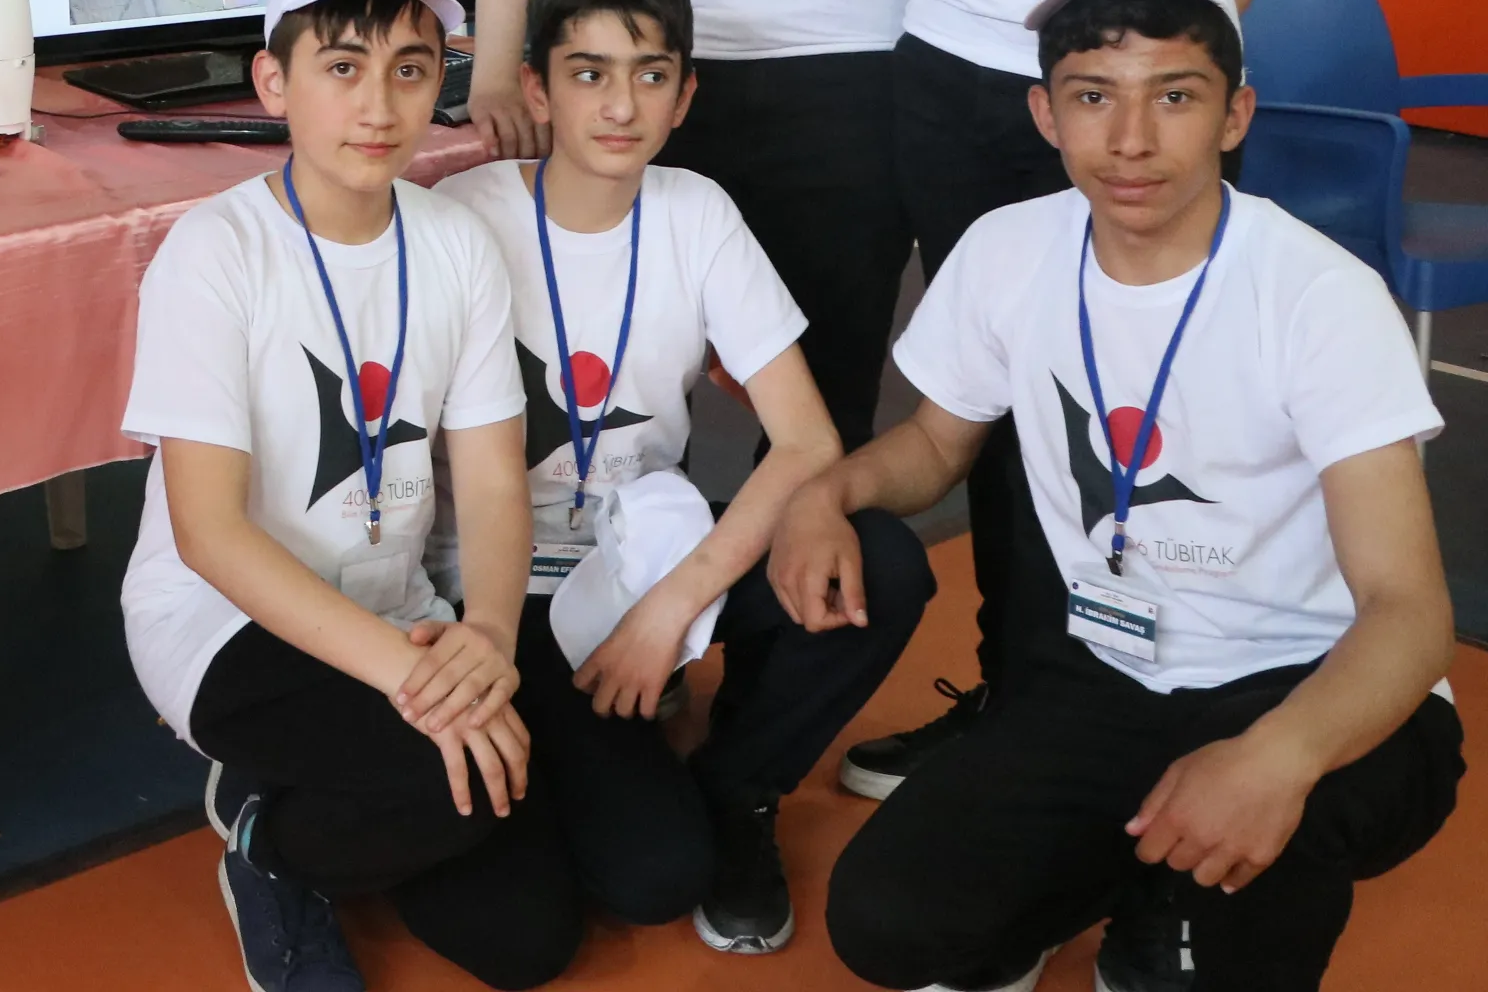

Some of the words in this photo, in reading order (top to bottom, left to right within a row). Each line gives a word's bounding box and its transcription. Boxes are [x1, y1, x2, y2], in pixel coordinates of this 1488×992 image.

[386, 476, 432, 501] TÜBİTA
[1154, 537, 1235, 565] TÜBİTAK
[532, 565, 560, 573] OSMAN
